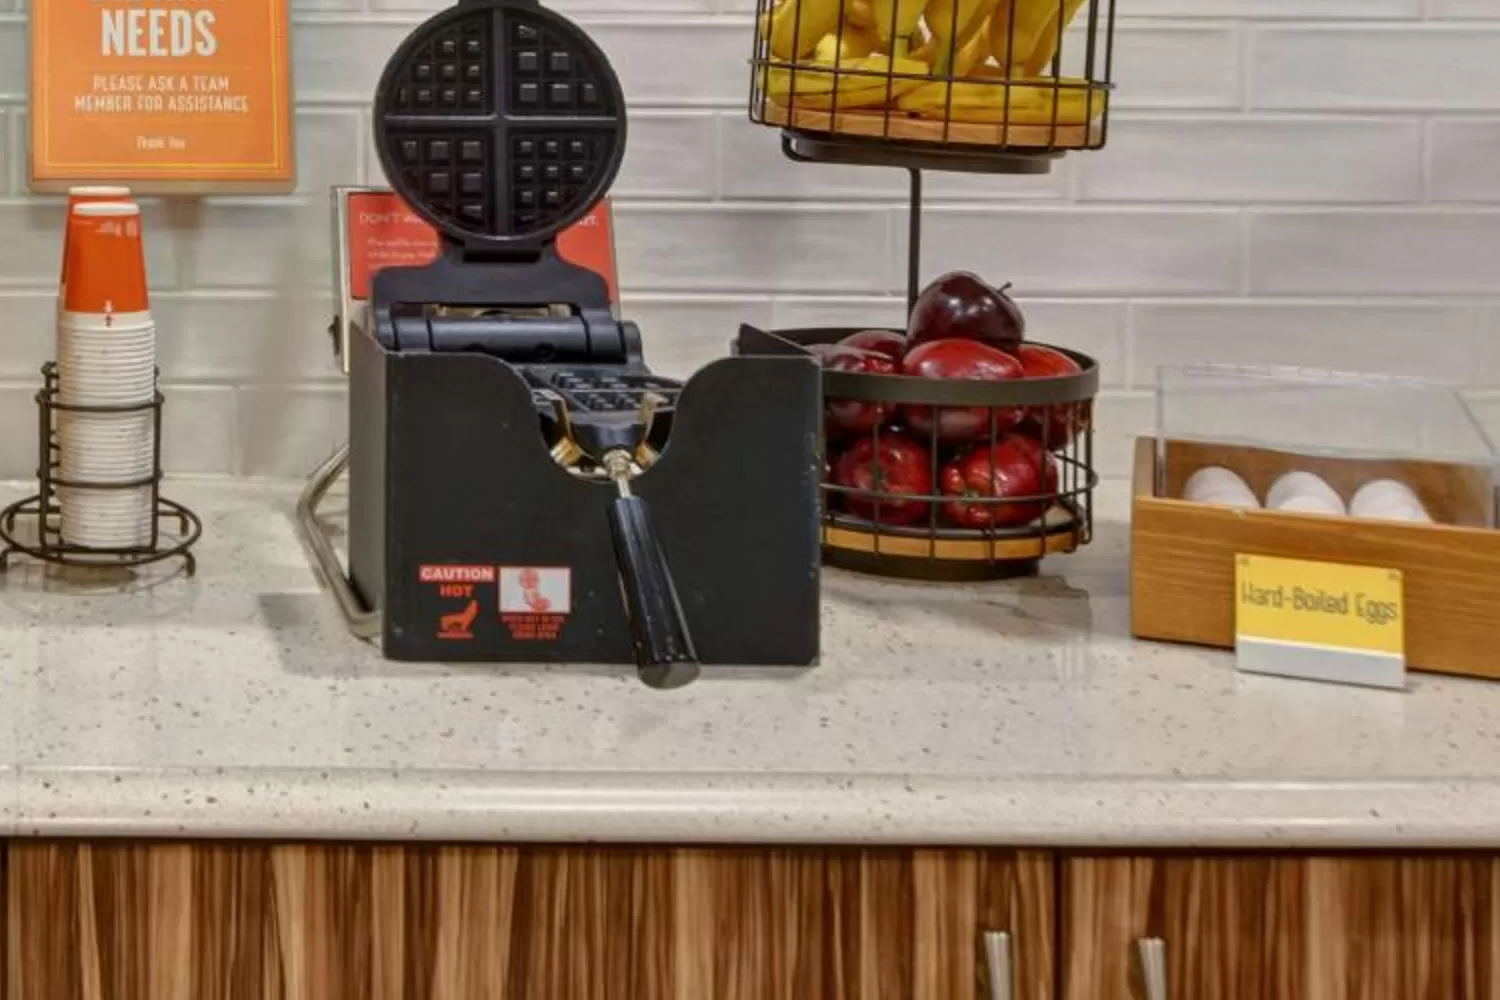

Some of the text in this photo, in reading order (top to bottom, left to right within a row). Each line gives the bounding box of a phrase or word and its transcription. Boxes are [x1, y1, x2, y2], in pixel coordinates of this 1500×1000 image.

[100, 9, 217, 57] NEEDS
[93, 75, 229, 92] PLEASE ASK A TEAM
[74, 95, 249, 113] MEMBER FOR ASSISTANCE
[421, 567, 494, 581] CAUTION
[440, 584, 473, 597] HOT
[1241, 582, 1397, 625] Hard-Boiled Eggs
